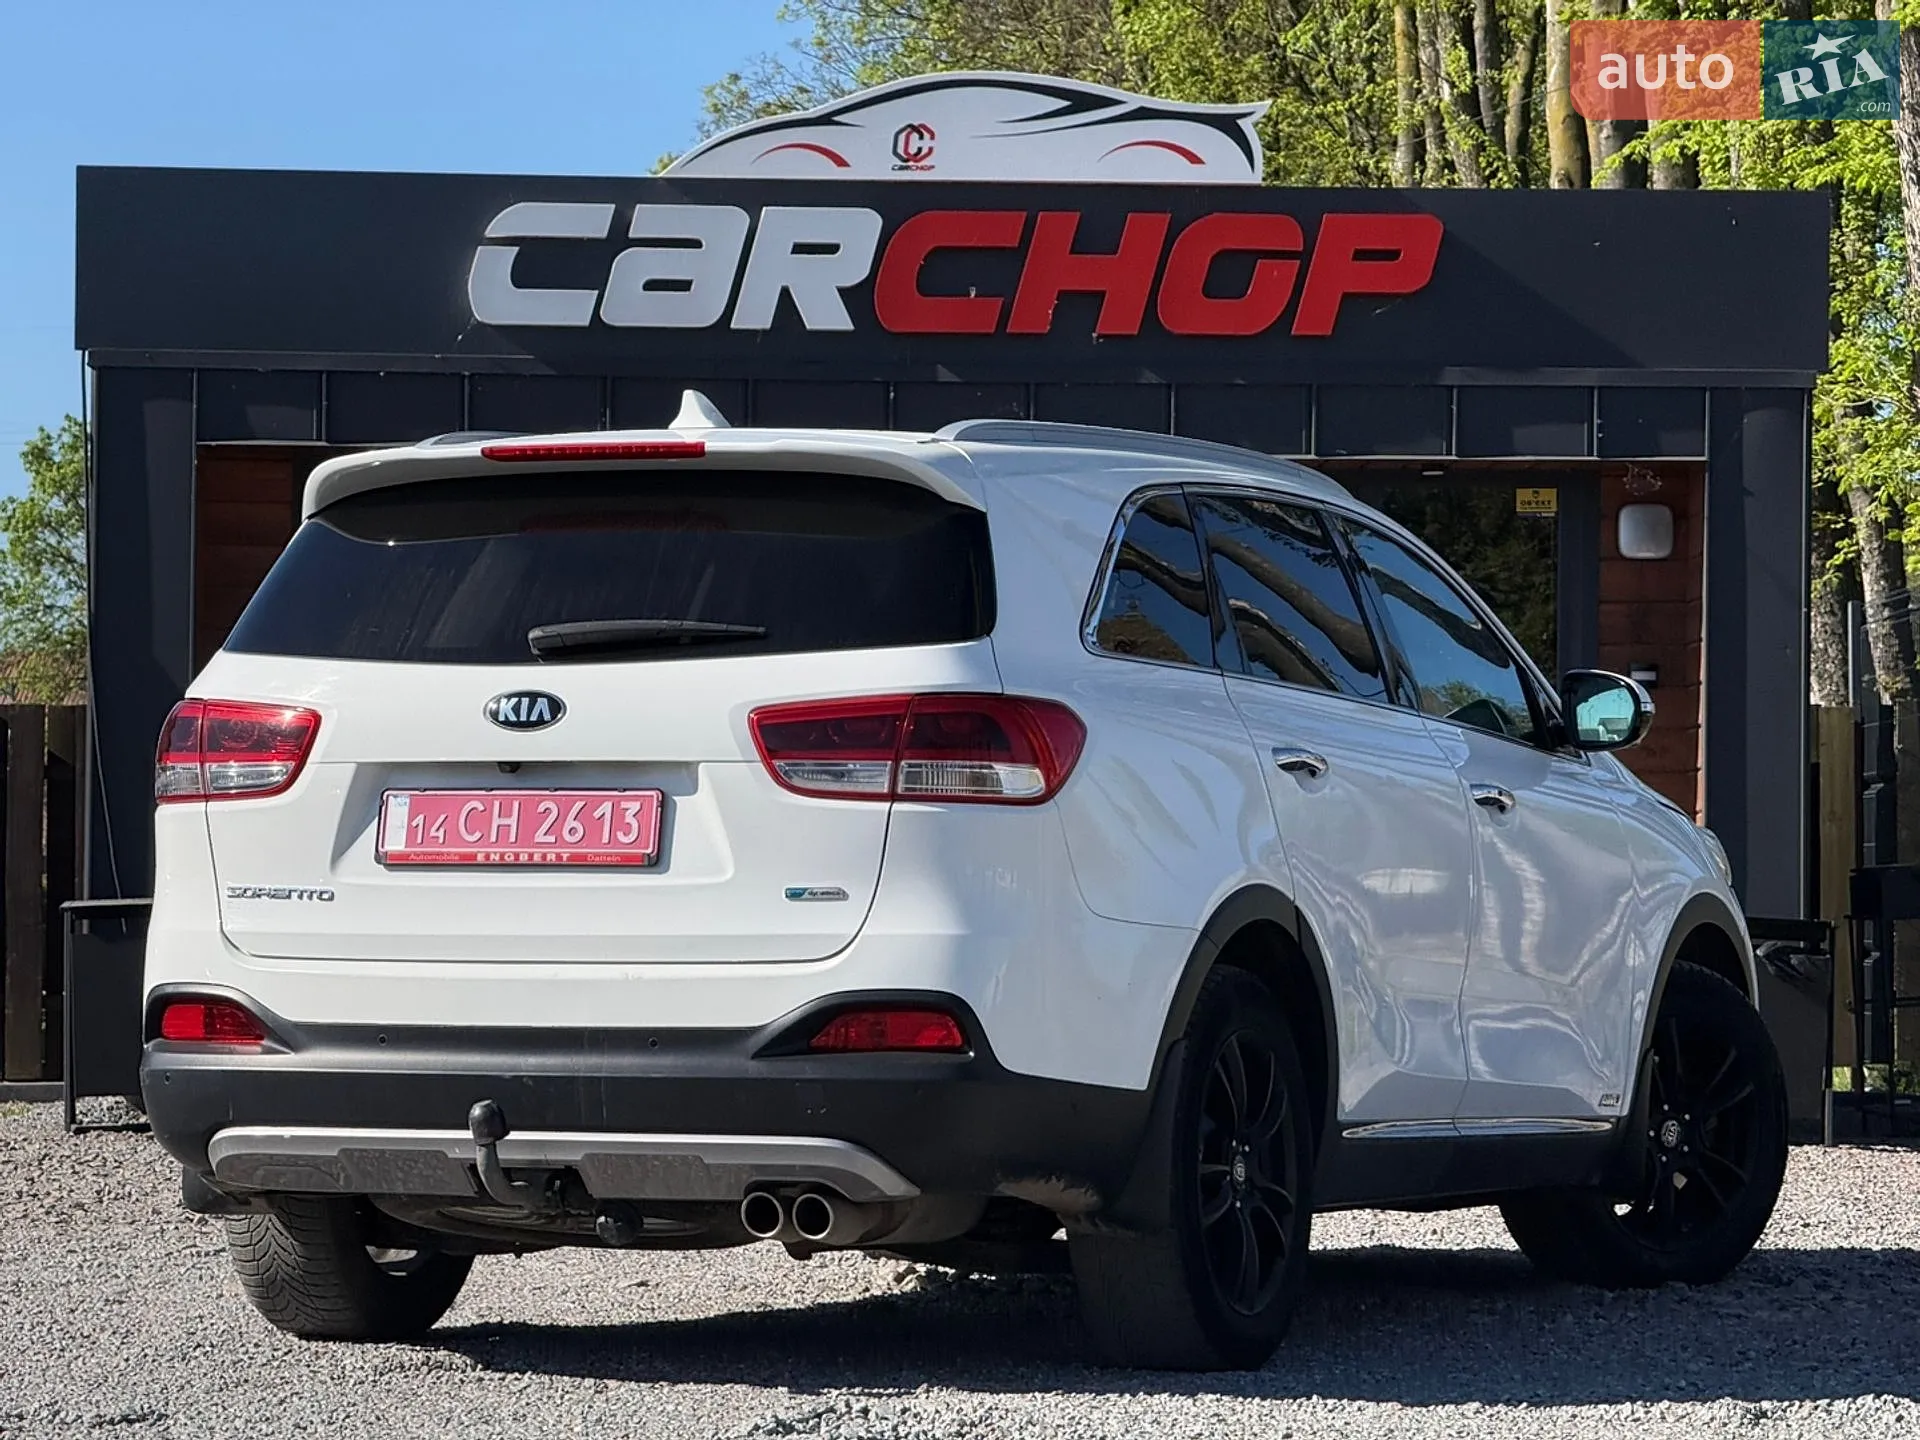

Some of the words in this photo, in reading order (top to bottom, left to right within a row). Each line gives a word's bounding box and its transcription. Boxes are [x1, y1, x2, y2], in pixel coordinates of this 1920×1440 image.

[498, 696, 552, 722] KIA
[410, 813, 448, 845] 14
[457, 800, 520, 844] CH
[533, 800, 644, 845] 2613
[476, 852, 571, 863] ENGBERT
[226, 886, 335, 902] SORENTO
